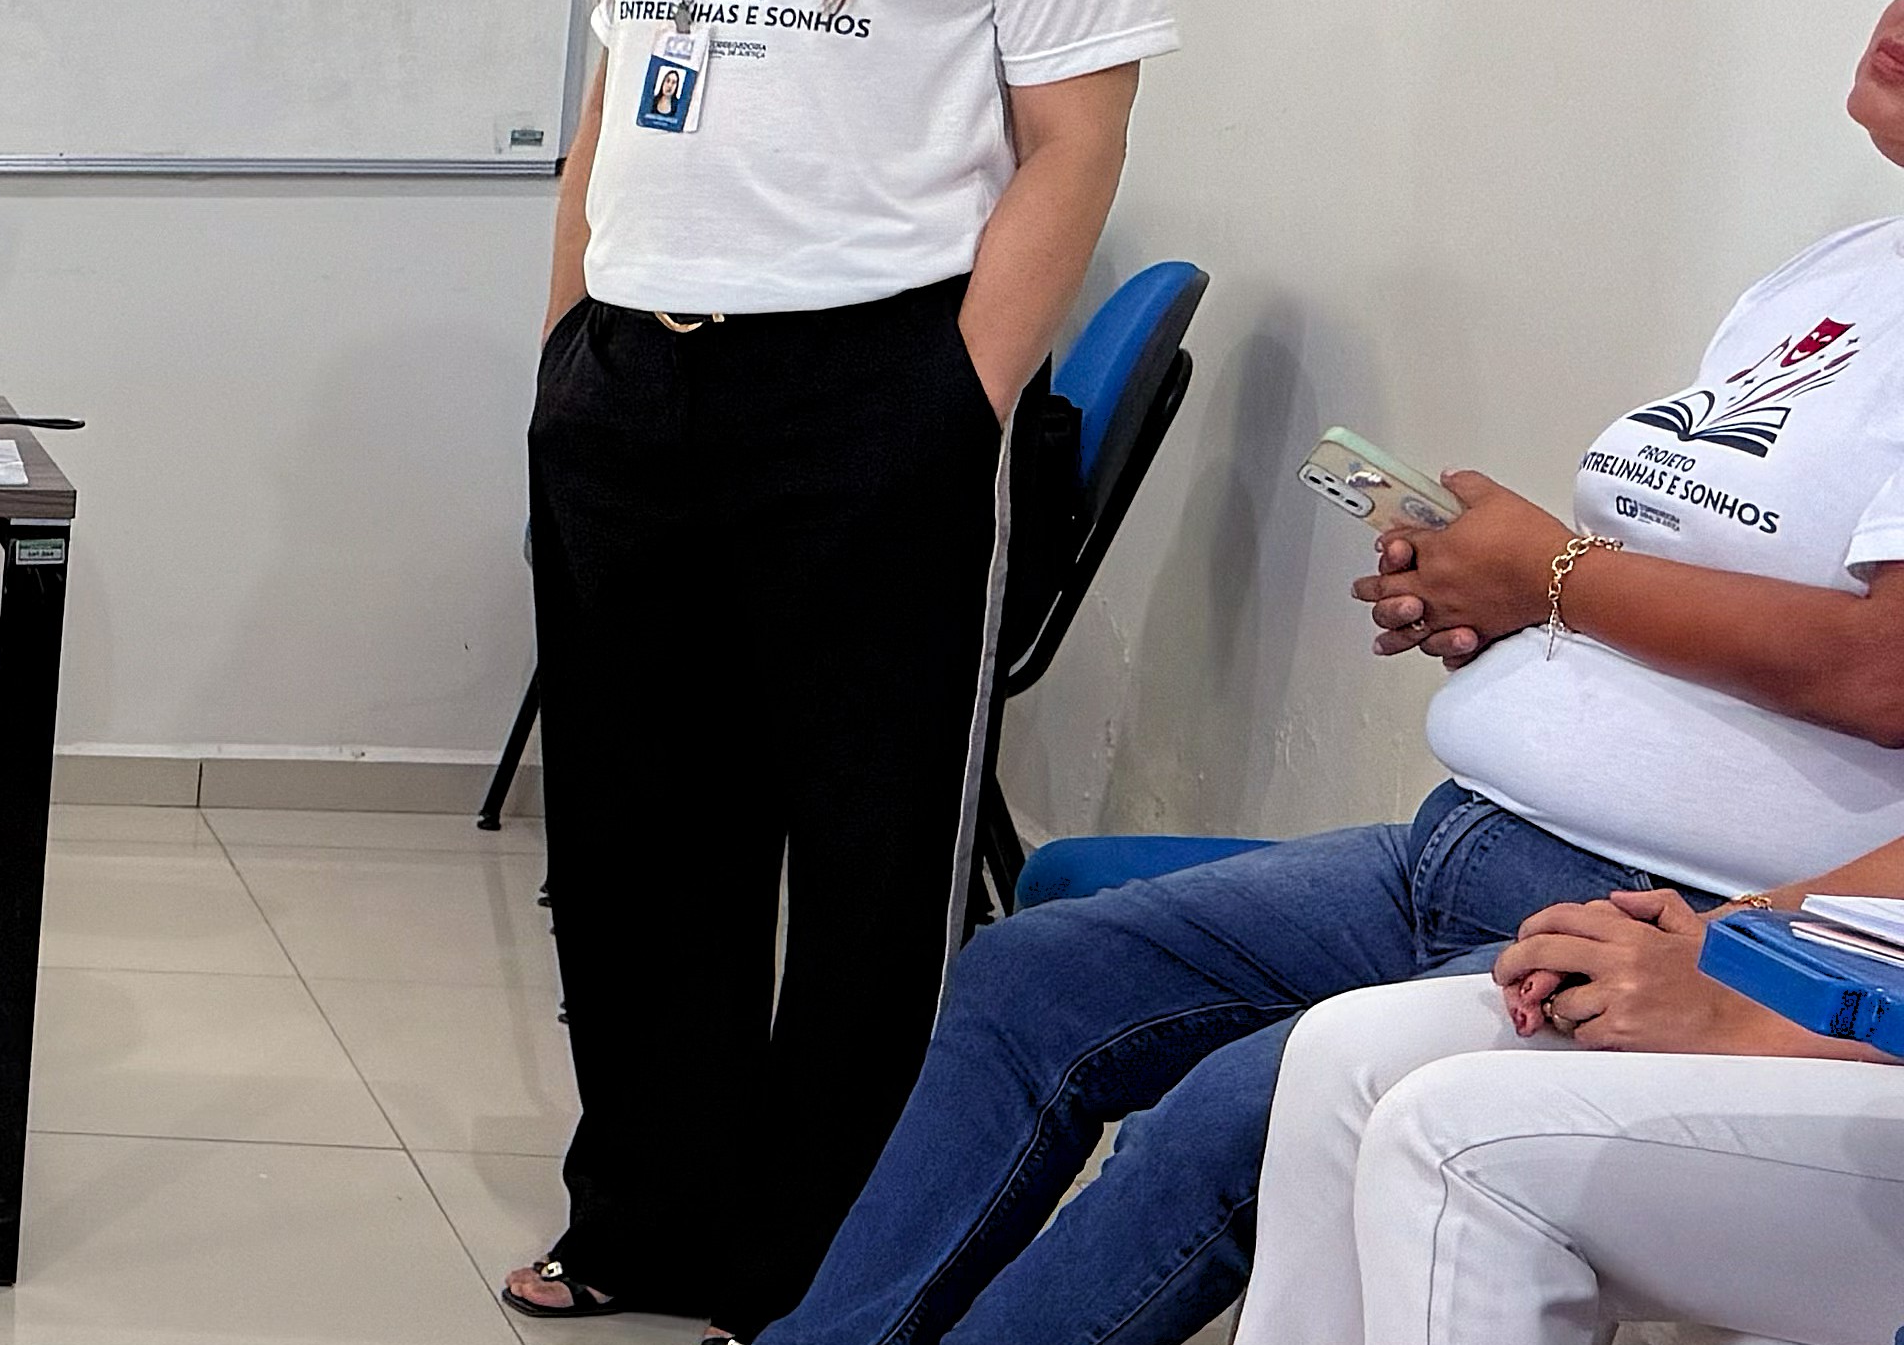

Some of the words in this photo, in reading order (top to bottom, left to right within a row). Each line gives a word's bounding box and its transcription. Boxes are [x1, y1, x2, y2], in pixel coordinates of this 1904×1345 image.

[745, 6, 760, 25] E
[764, 6, 871, 39] SONHOS
[1637, 444, 1697, 473] PROJETO
[1580, 451, 1669, 490] NTRELINHAS
[1666, 475, 1681, 495] E
[1679, 479, 1780, 534] SONHOS
